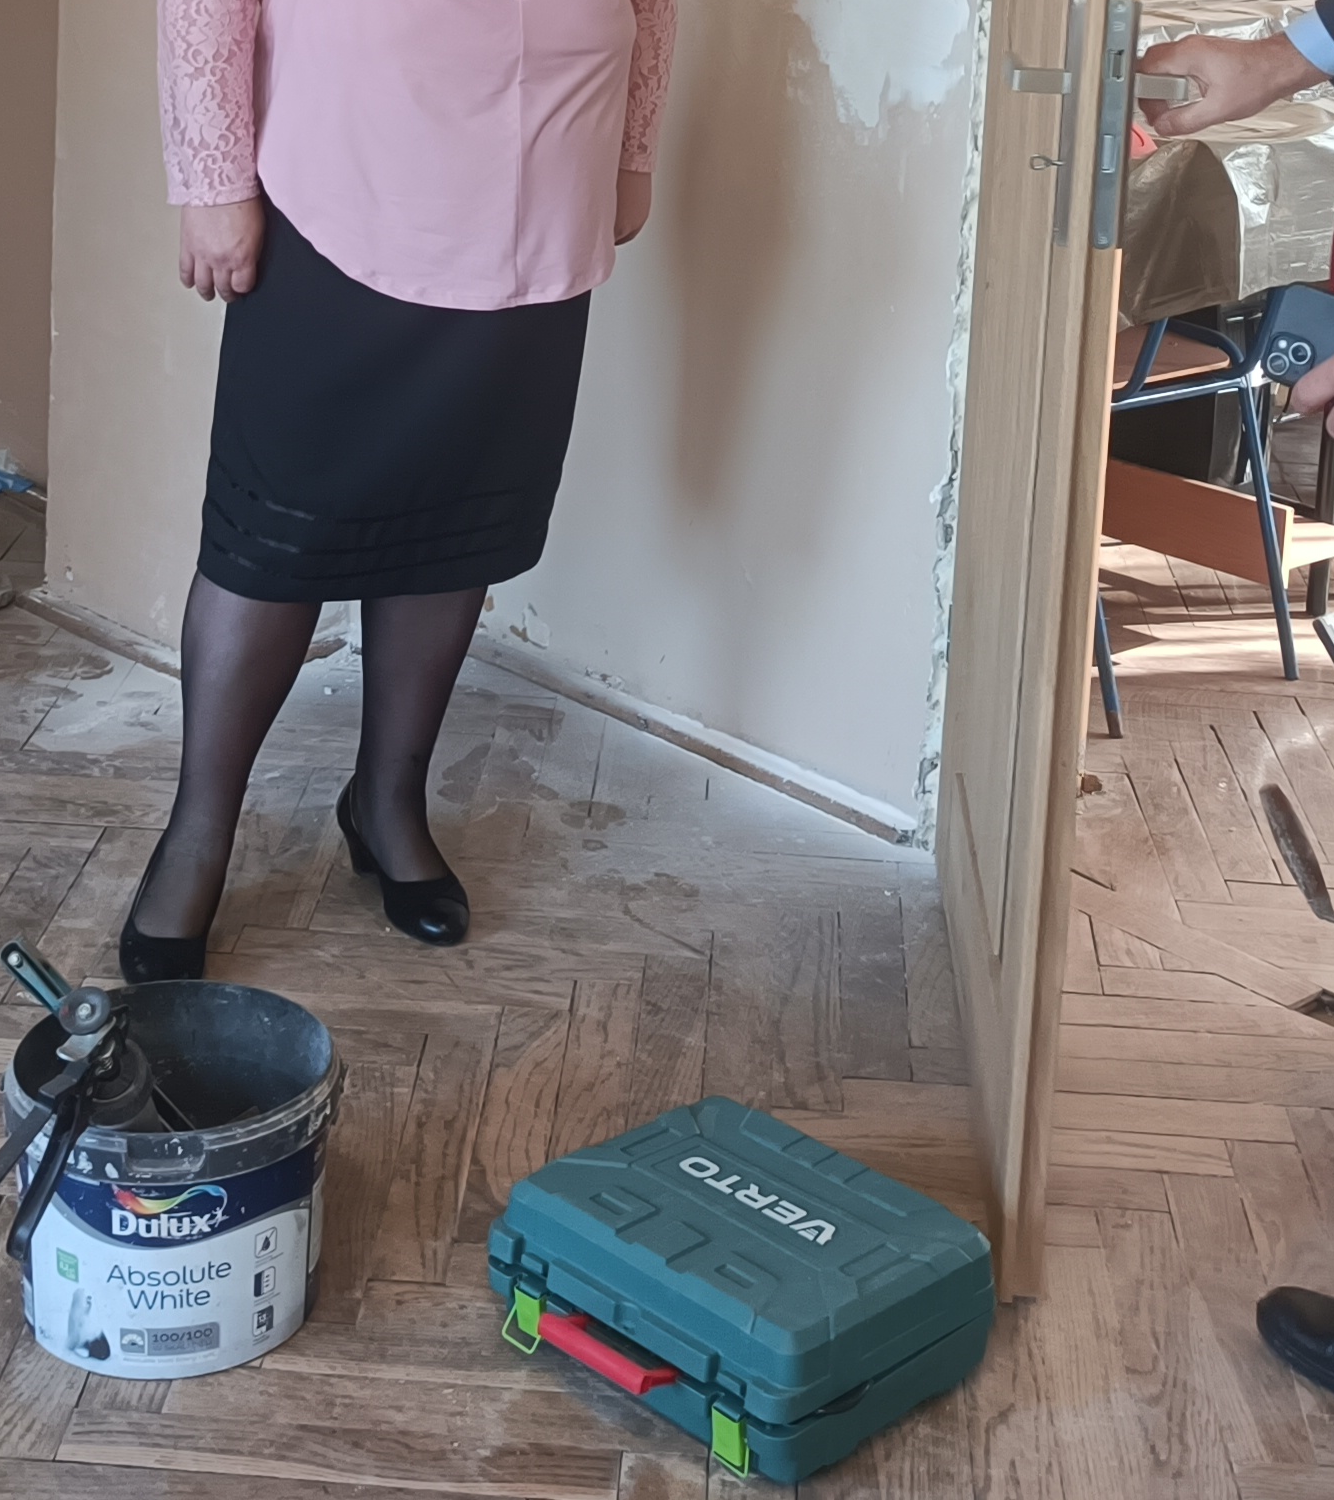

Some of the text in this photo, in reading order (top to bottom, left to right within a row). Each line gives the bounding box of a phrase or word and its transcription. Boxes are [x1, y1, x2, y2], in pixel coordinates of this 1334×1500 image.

[677, 1154, 838, 1248] VERTO
[111, 1208, 212, 1238] Dulux
[106, 1260, 233, 1287] Absolute
[127, 1287, 212, 1311] White
[151, 1327, 213, 1344] 100/100
